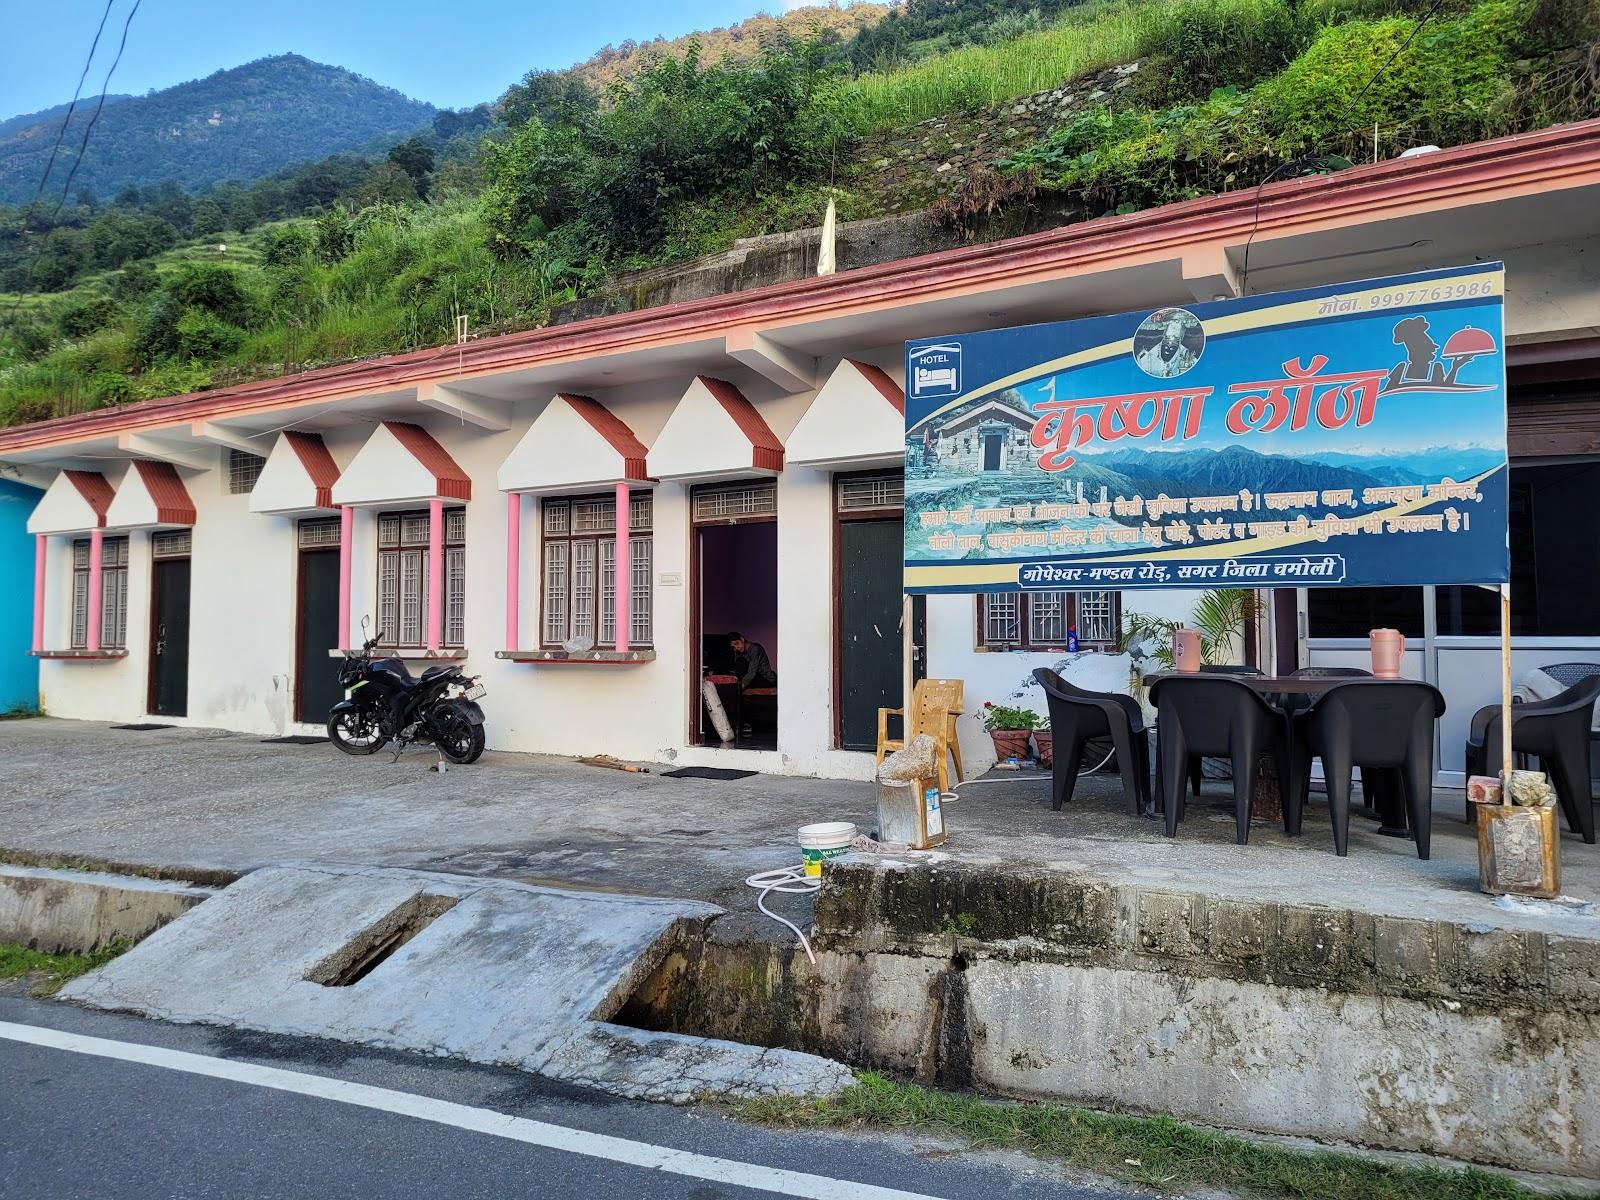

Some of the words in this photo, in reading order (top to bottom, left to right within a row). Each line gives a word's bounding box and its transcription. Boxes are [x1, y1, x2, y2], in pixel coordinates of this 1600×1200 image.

[1318, 295, 1362, 315] मोबा.
[1370, 281, 1492, 309] 9997763986
[920, 354, 949, 365] HOTEL
[1029, 386, 1215, 472] कृष्णा
[1225, 354, 1390, 435] लॉज
[919, 506, 948, 527] हमारे
[975, 507, 1011, 523] आवास
[1013, 502, 1033, 521] एवं
[1035, 500, 1071, 520] भोजन
[1073, 498, 1090, 518] की
[1113, 495, 1144, 516] जैसी
[1145, 493, 1188, 520] सुविधा
[1189, 495, 1239, 513] उपलब्ध
[1321, 488, 1358, 508] धाम,
[1362, 484, 1425, 508] अनसूया
[1426, 476, 1483, 502] मन्दिर,
[1049, 525, 1087, 545] मन्दिर
[1089, 523, 1106, 544] की
[1109, 526, 1140, 543] यात्रा
[1142, 521, 1162, 547] हेतु
[1197, 517, 1231, 540] पोर्टर
[1233, 522, 1246, 539] व
[1248, 521, 1287, 541] गाइड
[1288, 514, 1309, 536] की
[1312, 513, 1359, 542] सुविधा
[1363, 512, 1385, 535] भी
[1386, 514, 1444, 532] उपलब्ध
[1138, 562, 1171, 582] रोड़,
[1177, 565, 1220, 578] सगर
[1221, 559, 1271, 578] जिला
[1274, 557, 1337, 576] चमोली
